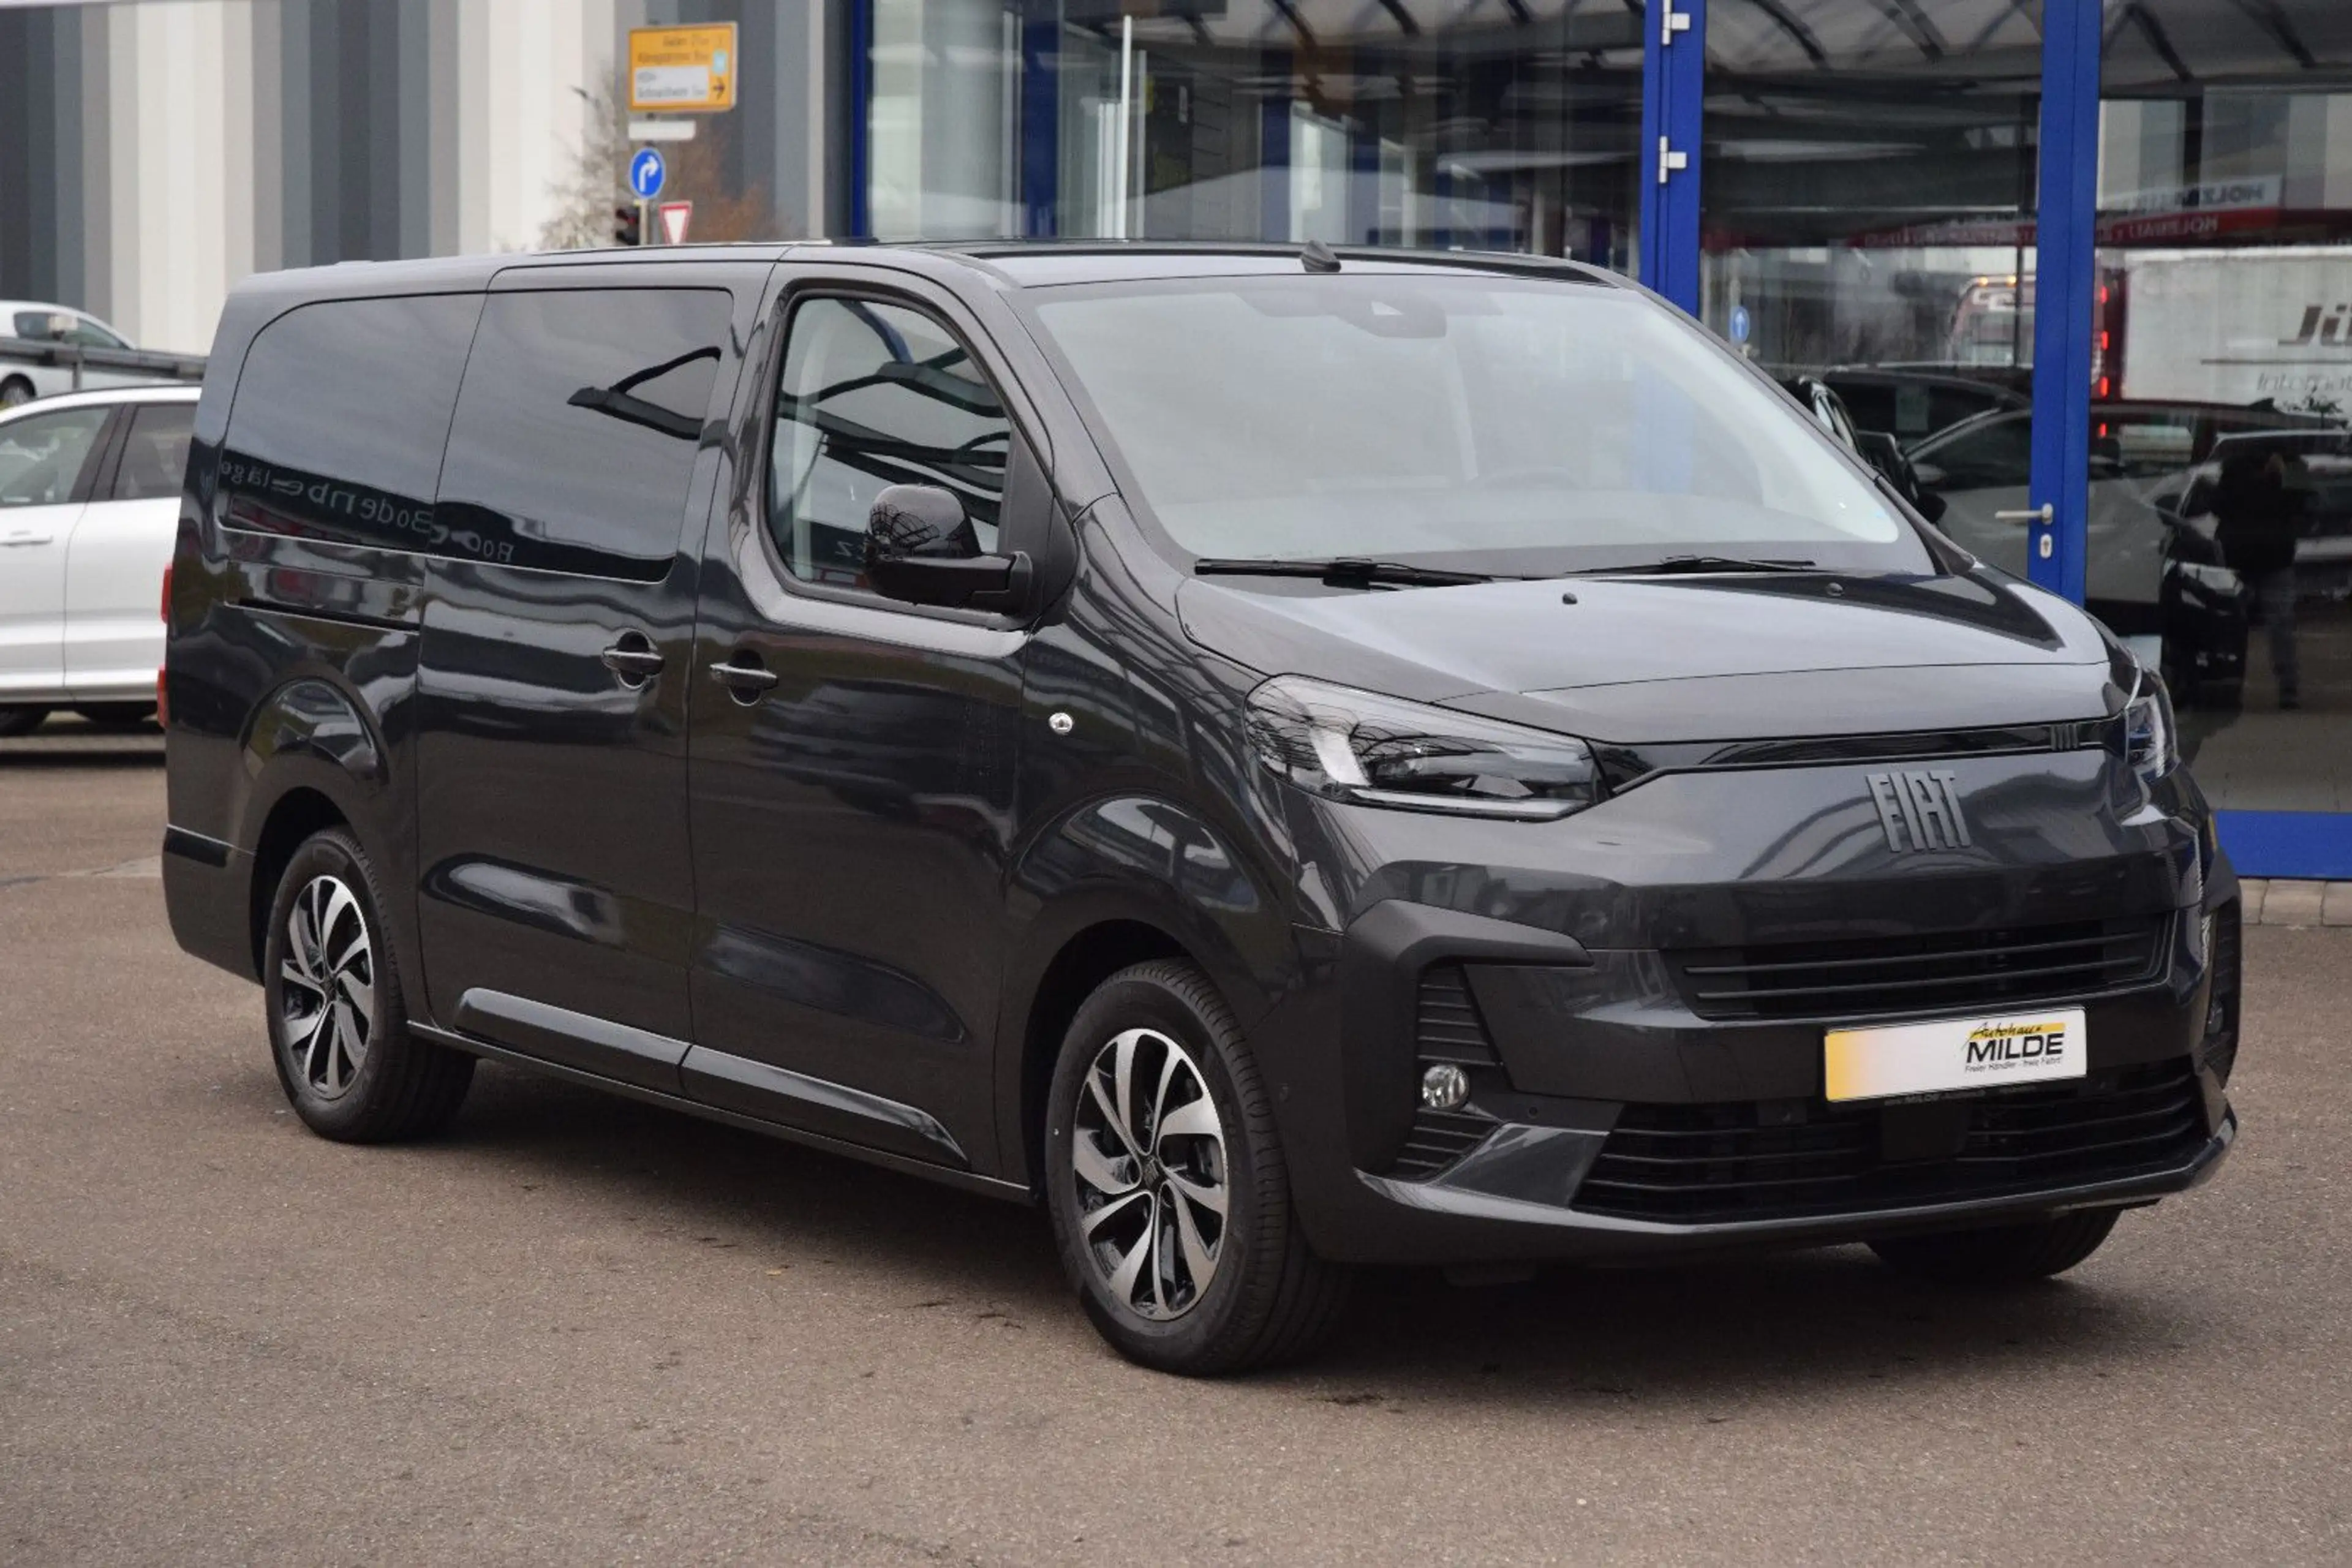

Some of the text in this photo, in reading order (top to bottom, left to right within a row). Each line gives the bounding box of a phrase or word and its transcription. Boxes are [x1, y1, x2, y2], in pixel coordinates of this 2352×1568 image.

[1866, 770, 1971, 853] FIAT
[1962, 1021, 2043, 1048] Autohaus
[1966, 1033, 2064, 1063] MILDE
